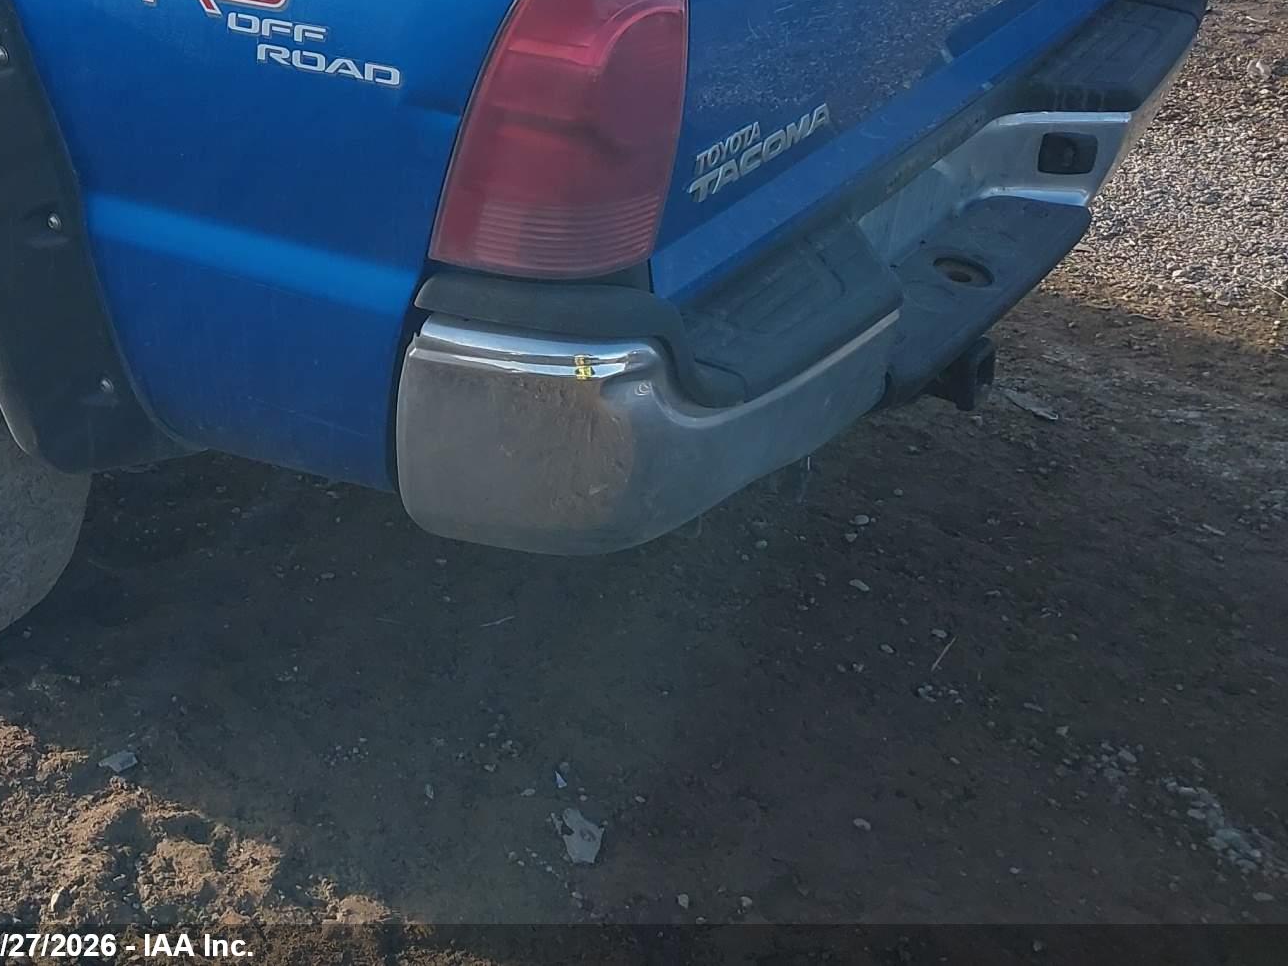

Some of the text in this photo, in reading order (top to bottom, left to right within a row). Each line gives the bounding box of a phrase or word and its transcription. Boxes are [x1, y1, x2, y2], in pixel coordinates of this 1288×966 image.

[227, 11, 328, 43] OFF
[256, 43, 402, 87] ROAD
[687, 103, 831, 203] TACOMA
[696, 121, 761, 175] TOYOTA
